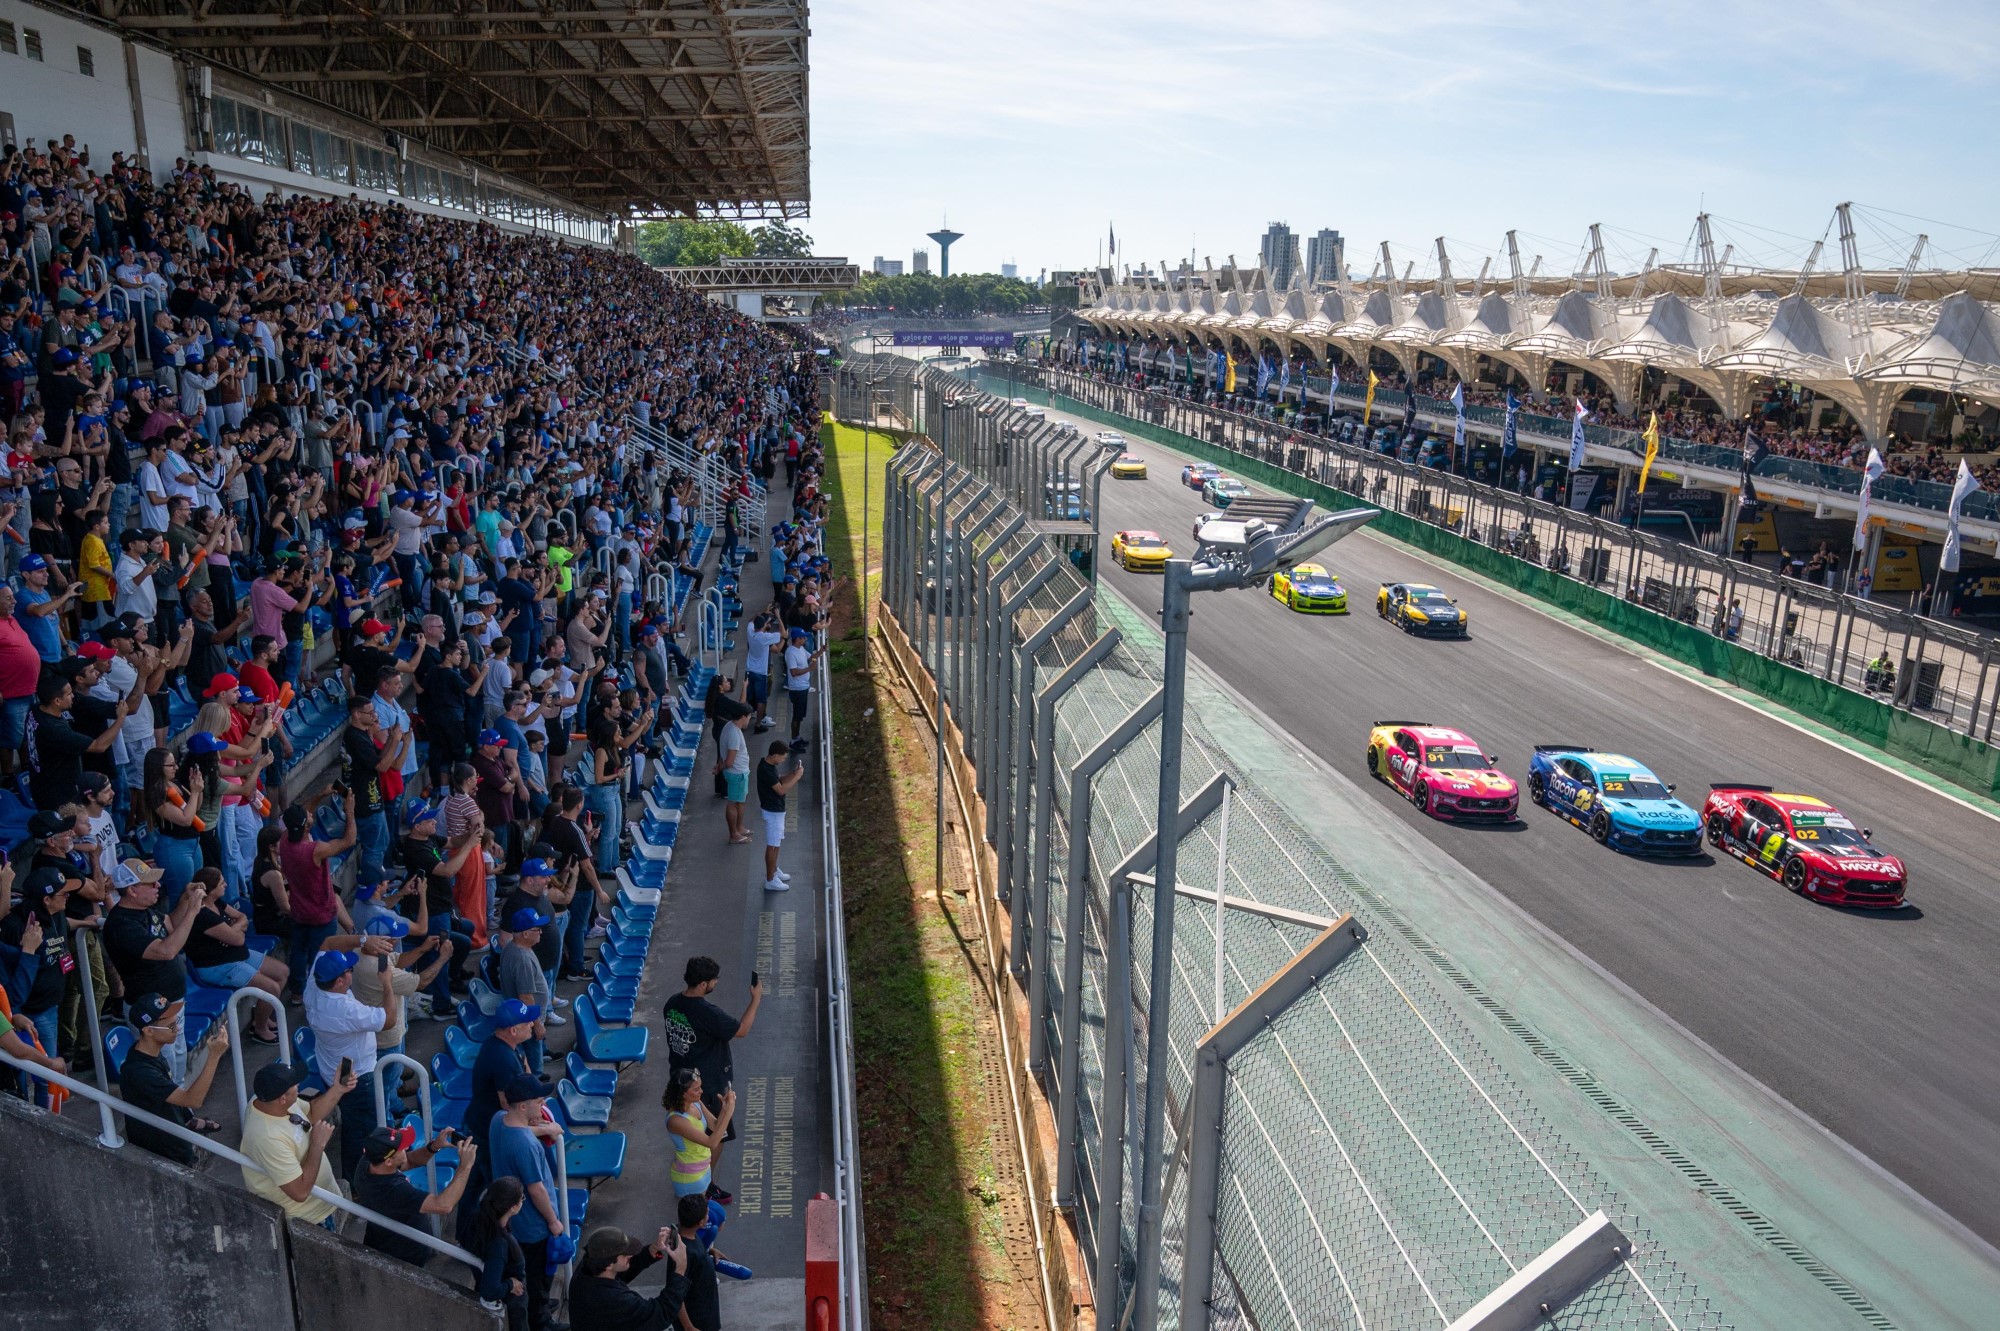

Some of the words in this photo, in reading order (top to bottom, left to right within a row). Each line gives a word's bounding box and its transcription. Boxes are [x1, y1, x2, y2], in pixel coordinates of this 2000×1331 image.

[1428, 754, 1444, 762] 91
[1604, 782, 1624, 791] 22
[1796, 830, 1820, 840] 02
[1840, 863, 1899, 874] MAXON
[746, 1077, 768, 1116] PESSOAS
[744, 1118, 766, 1132] EM
[744, 1134, 768, 1146] PÉ
[742, 1149, 764, 1179] NESTE
[770, 1130, 798, 1201] PERMANÊNCIA
[738, 1182, 763, 1218] LOCAL
[770, 1204, 793, 1218] DE
